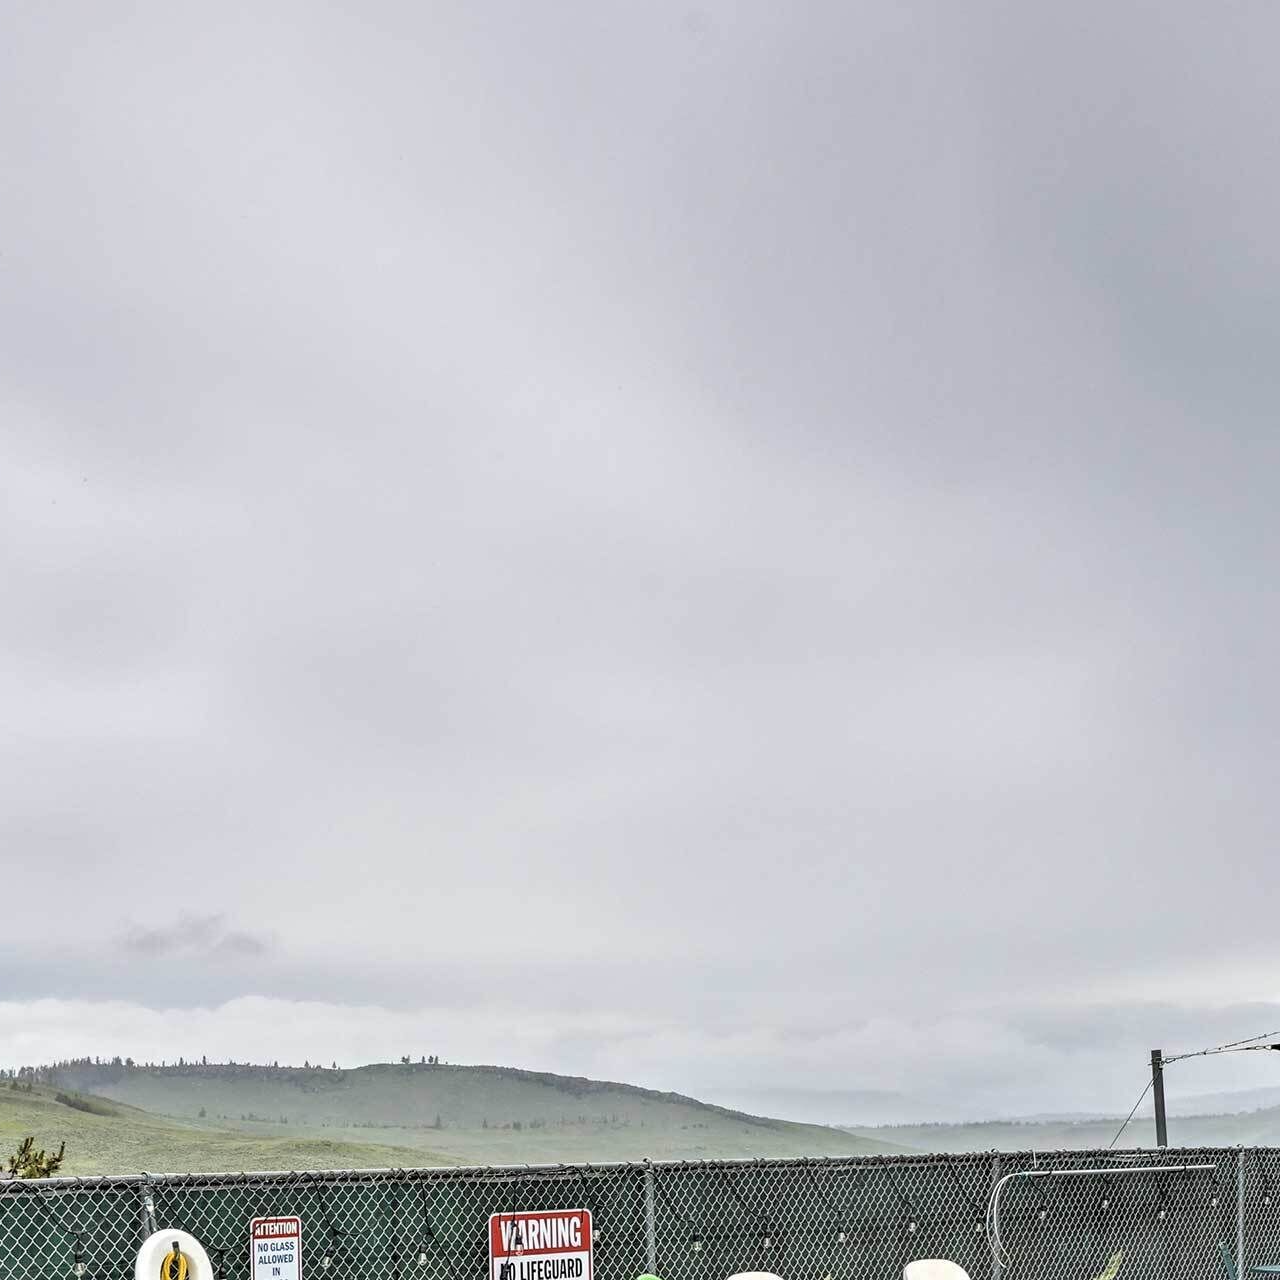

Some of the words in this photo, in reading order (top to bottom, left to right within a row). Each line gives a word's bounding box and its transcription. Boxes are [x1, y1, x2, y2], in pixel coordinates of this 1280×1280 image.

[255, 1221, 297, 1236] ATTENTION
[500, 1216, 582, 1252] WARNING
[258, 1243, 268, 1252] NO
[270, 1241, 295, 1252] GLASS
[258, 1254, 294, 1265] ALLOWED
[272, 1267, 281, 1276] IN
